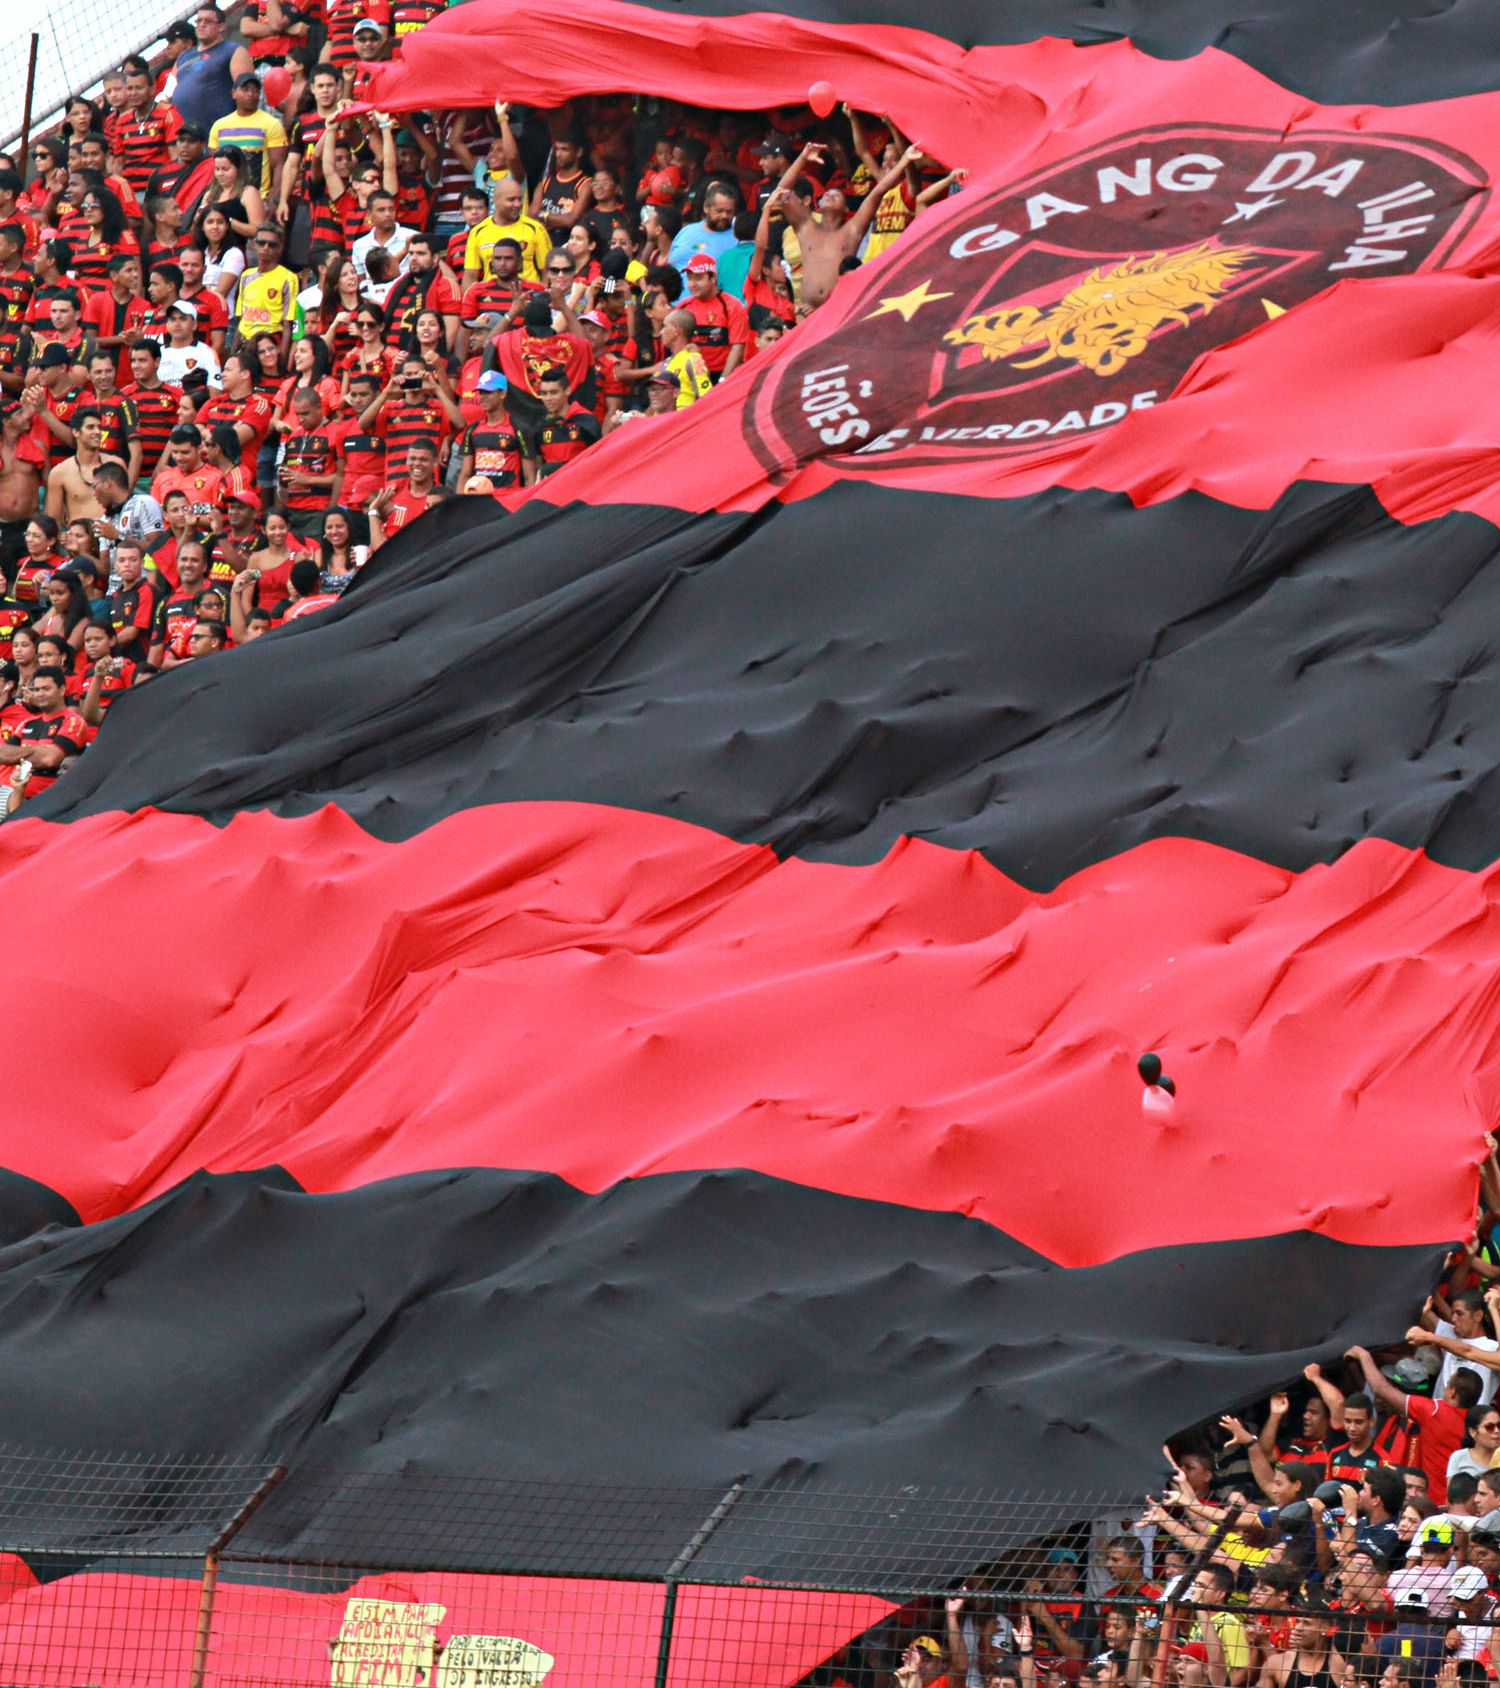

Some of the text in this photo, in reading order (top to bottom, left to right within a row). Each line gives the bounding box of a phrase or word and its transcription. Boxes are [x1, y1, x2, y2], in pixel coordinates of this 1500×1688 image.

[949, 151, 1435, 271] GANG DA ILHA
[801, 364, 873, 446] LEÕES
